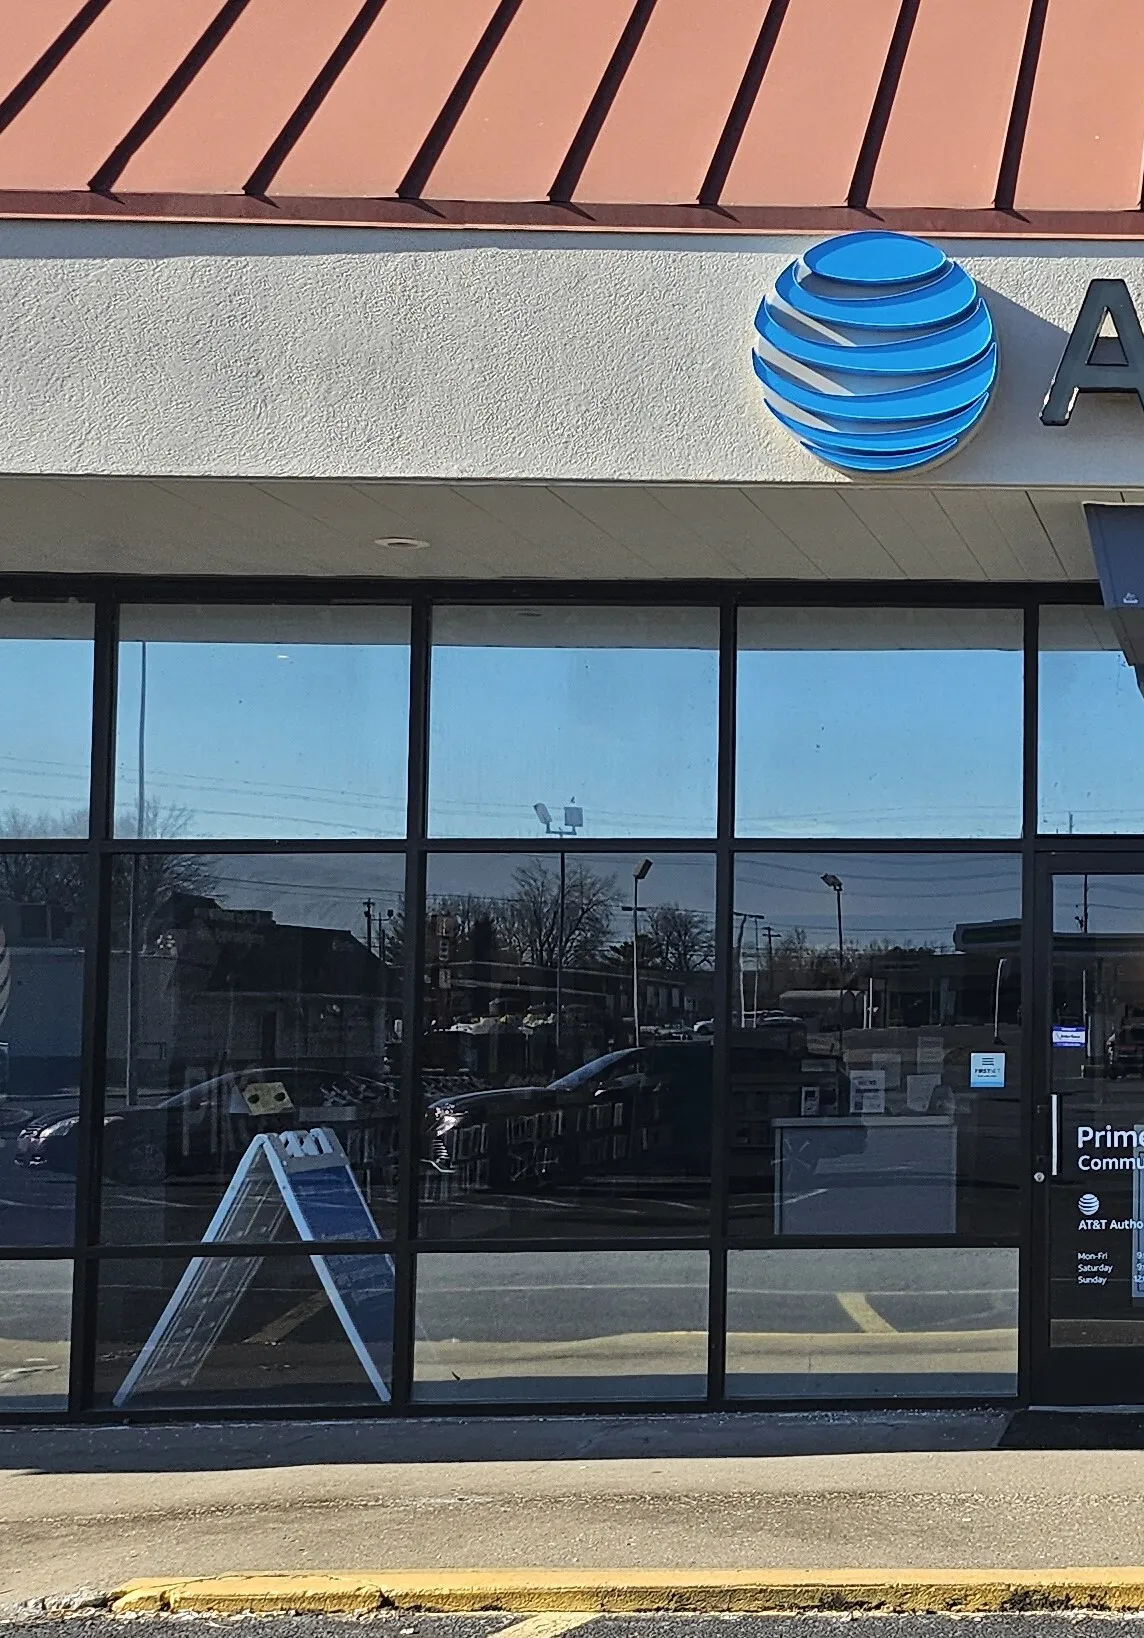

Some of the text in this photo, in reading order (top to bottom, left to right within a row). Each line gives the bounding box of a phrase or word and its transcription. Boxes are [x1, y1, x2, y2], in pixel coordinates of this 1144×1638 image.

[1078, 1219, 1108, 1231] AT&T
[1077, 1252, 1108, 1260] Mon-Fri
[1077, 1263, 1113, 1273] Saturday
[1077, 1275, 1108, 1285] Sunday
